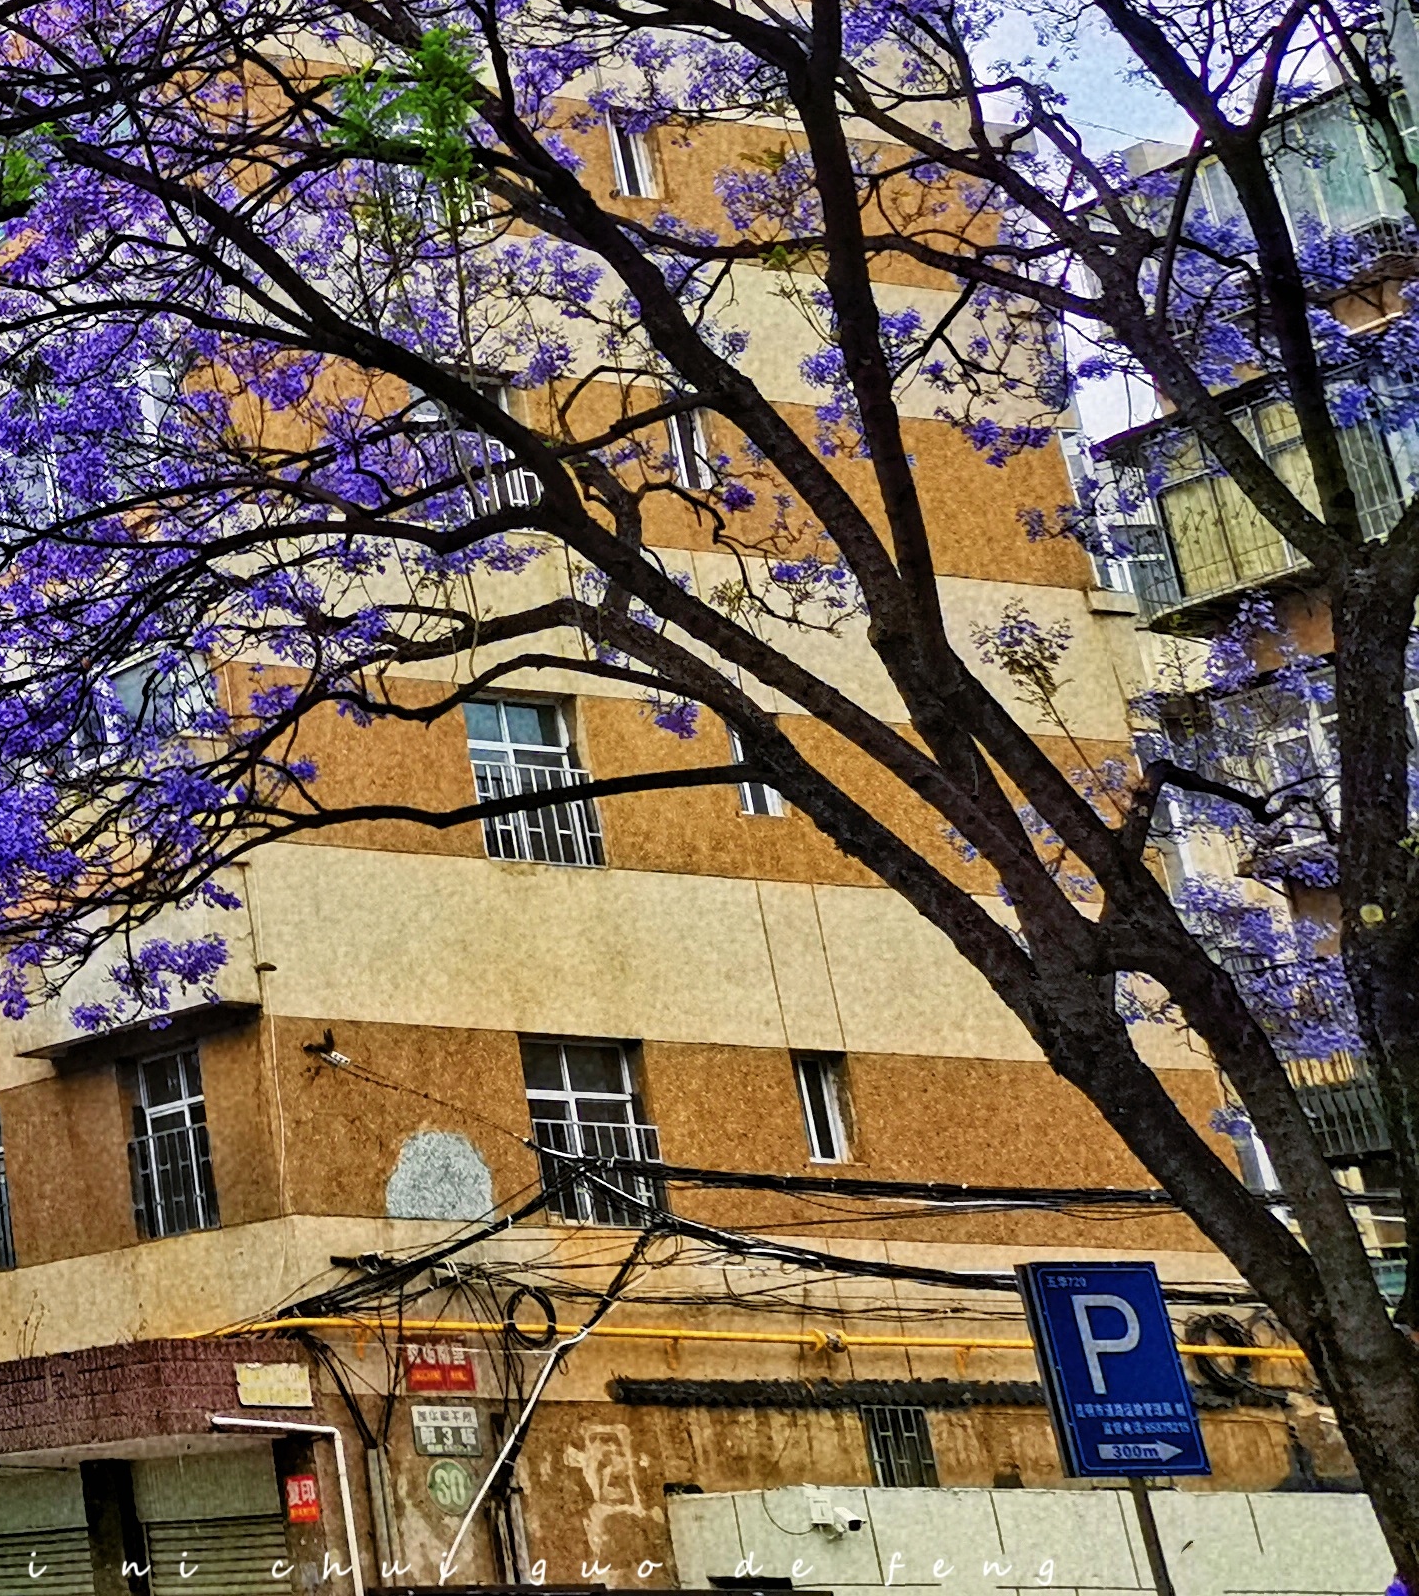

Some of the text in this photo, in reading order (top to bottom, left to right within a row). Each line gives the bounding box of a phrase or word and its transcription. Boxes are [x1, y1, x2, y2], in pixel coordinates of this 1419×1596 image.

[1070, 1294, 1140, 1395] P
[1112, 1444, 1159, 1459] 300m
[434, 1468, 467, 1505] 30
